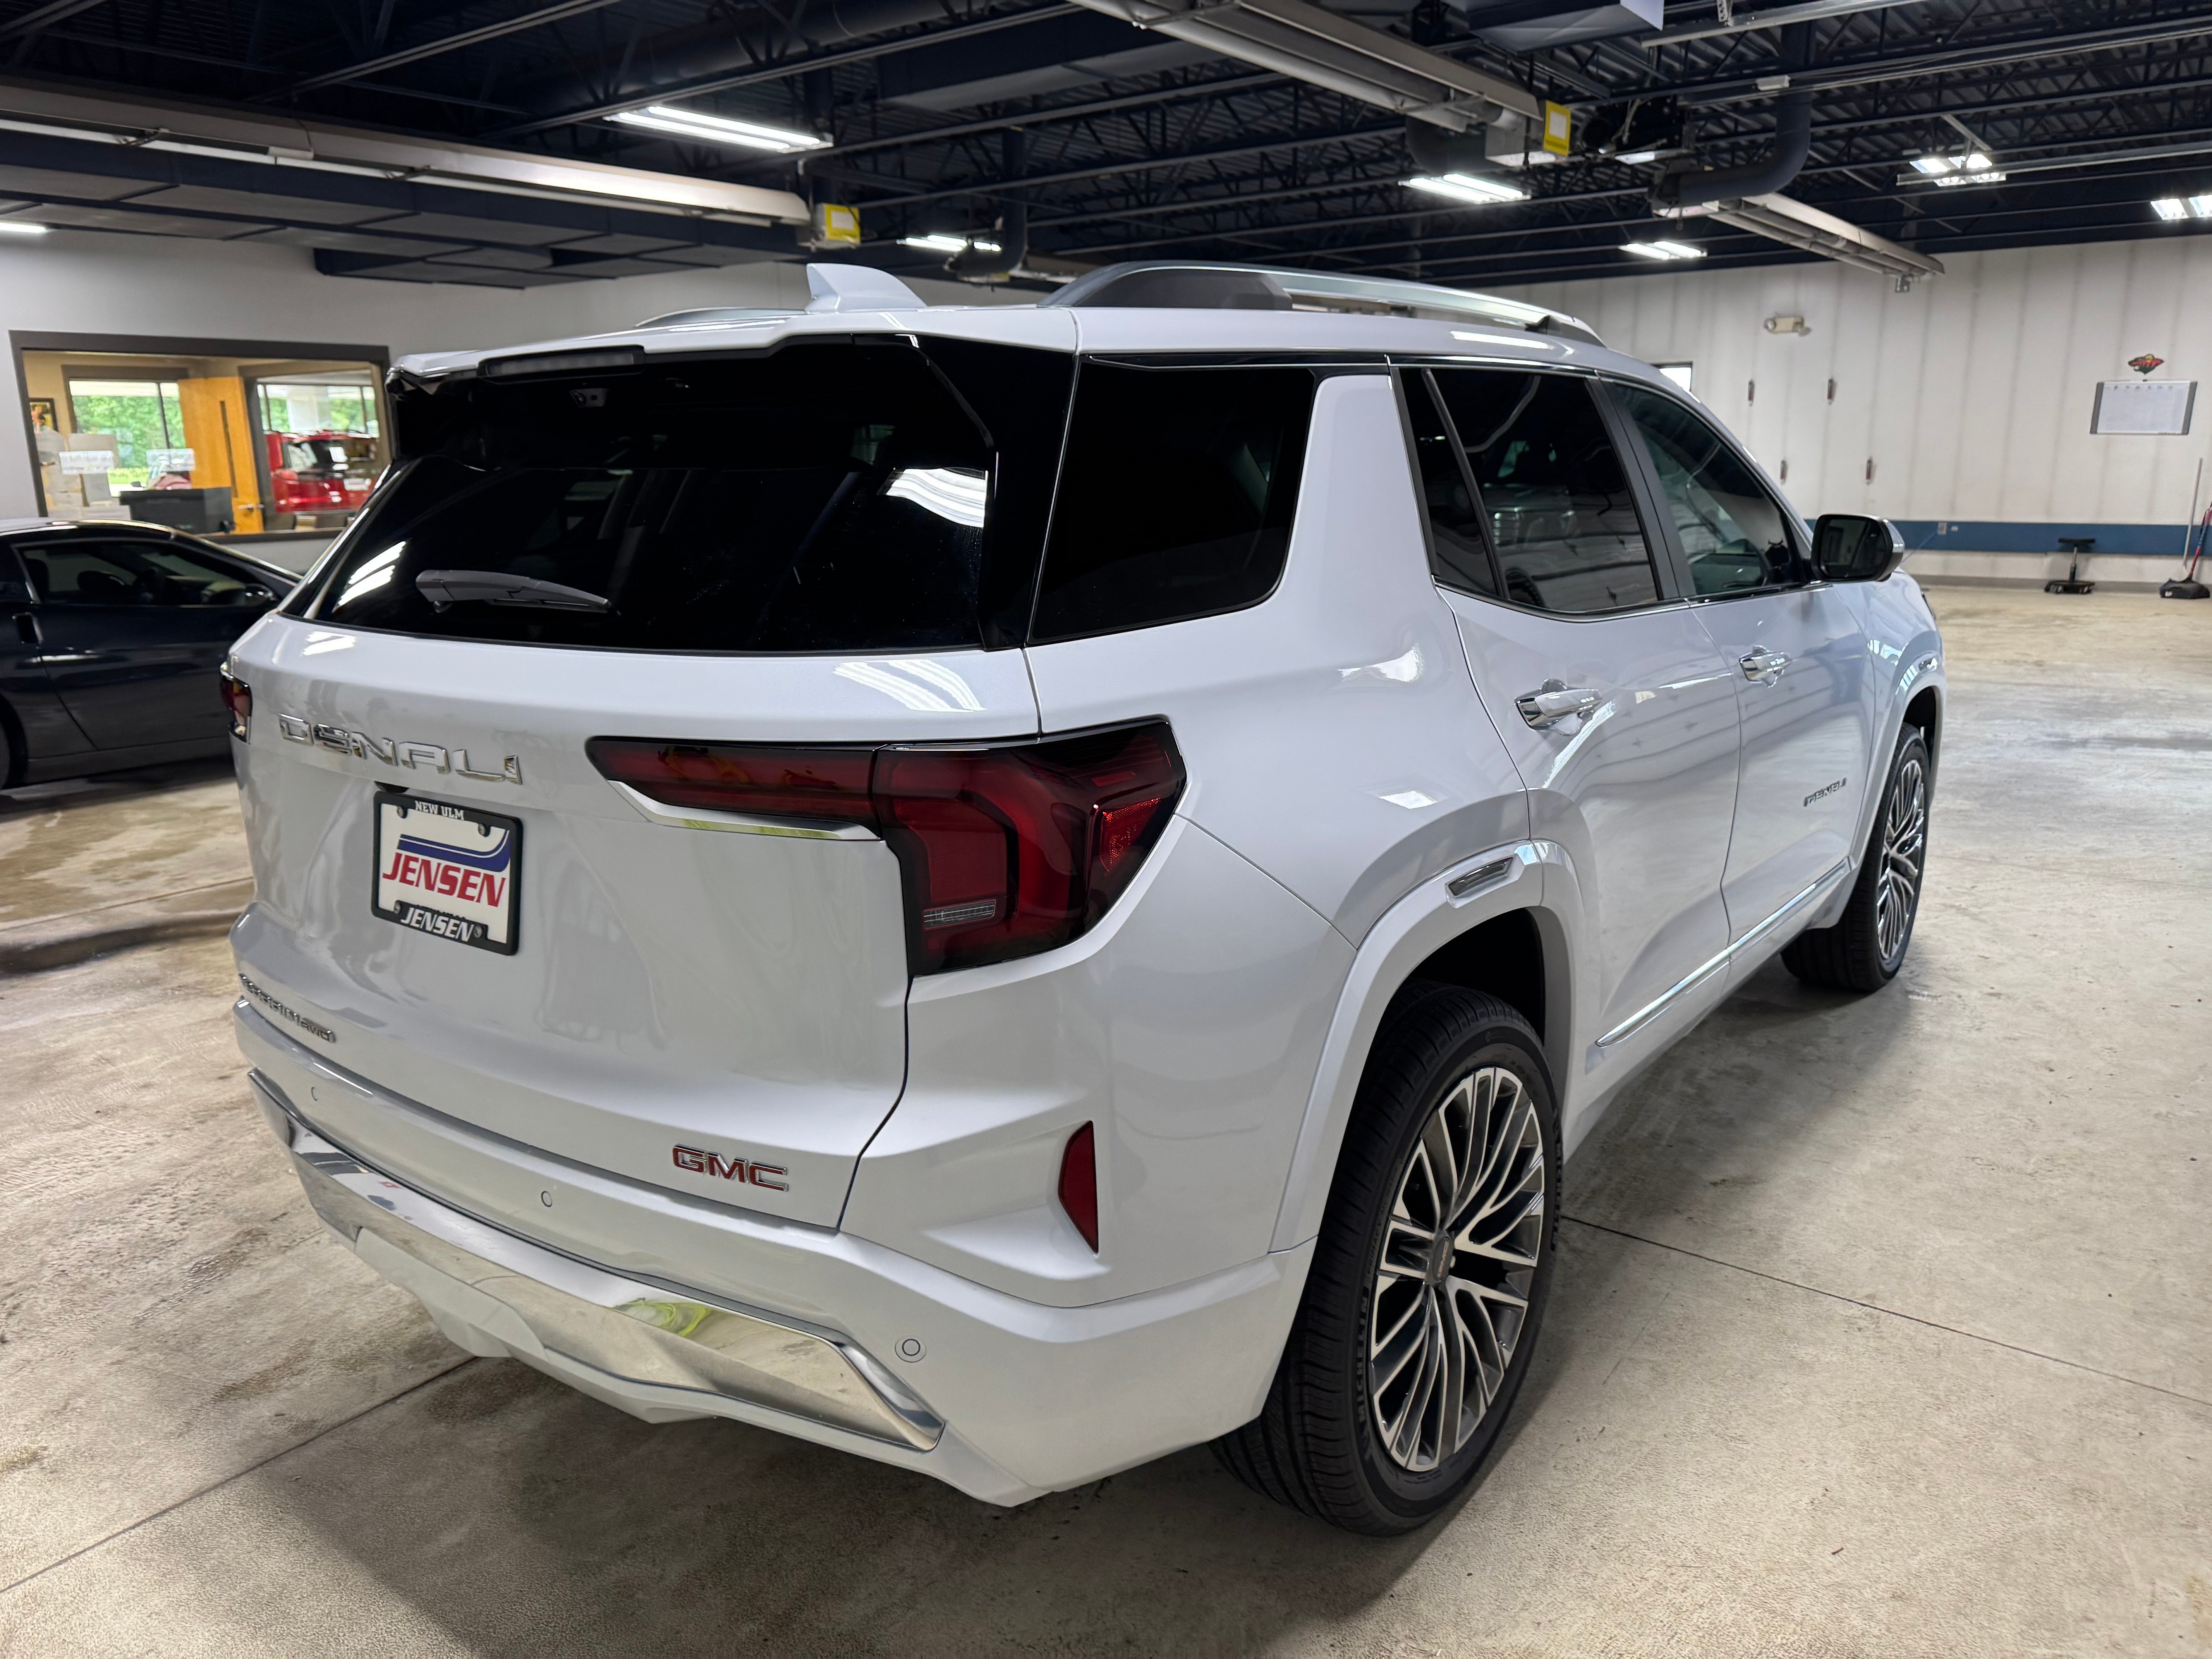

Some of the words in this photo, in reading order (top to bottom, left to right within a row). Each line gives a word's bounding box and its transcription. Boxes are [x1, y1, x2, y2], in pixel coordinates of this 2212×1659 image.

[278, 713, 522, 785] DENALI
[414, 800, 438, 814] NEW
[441, 805, 464, 820] ULM
[382, 852, 506, 907] JENSEN
[400, 907, 474, 942] JENSEN
[672, 1144, 789, 1192] GMC
